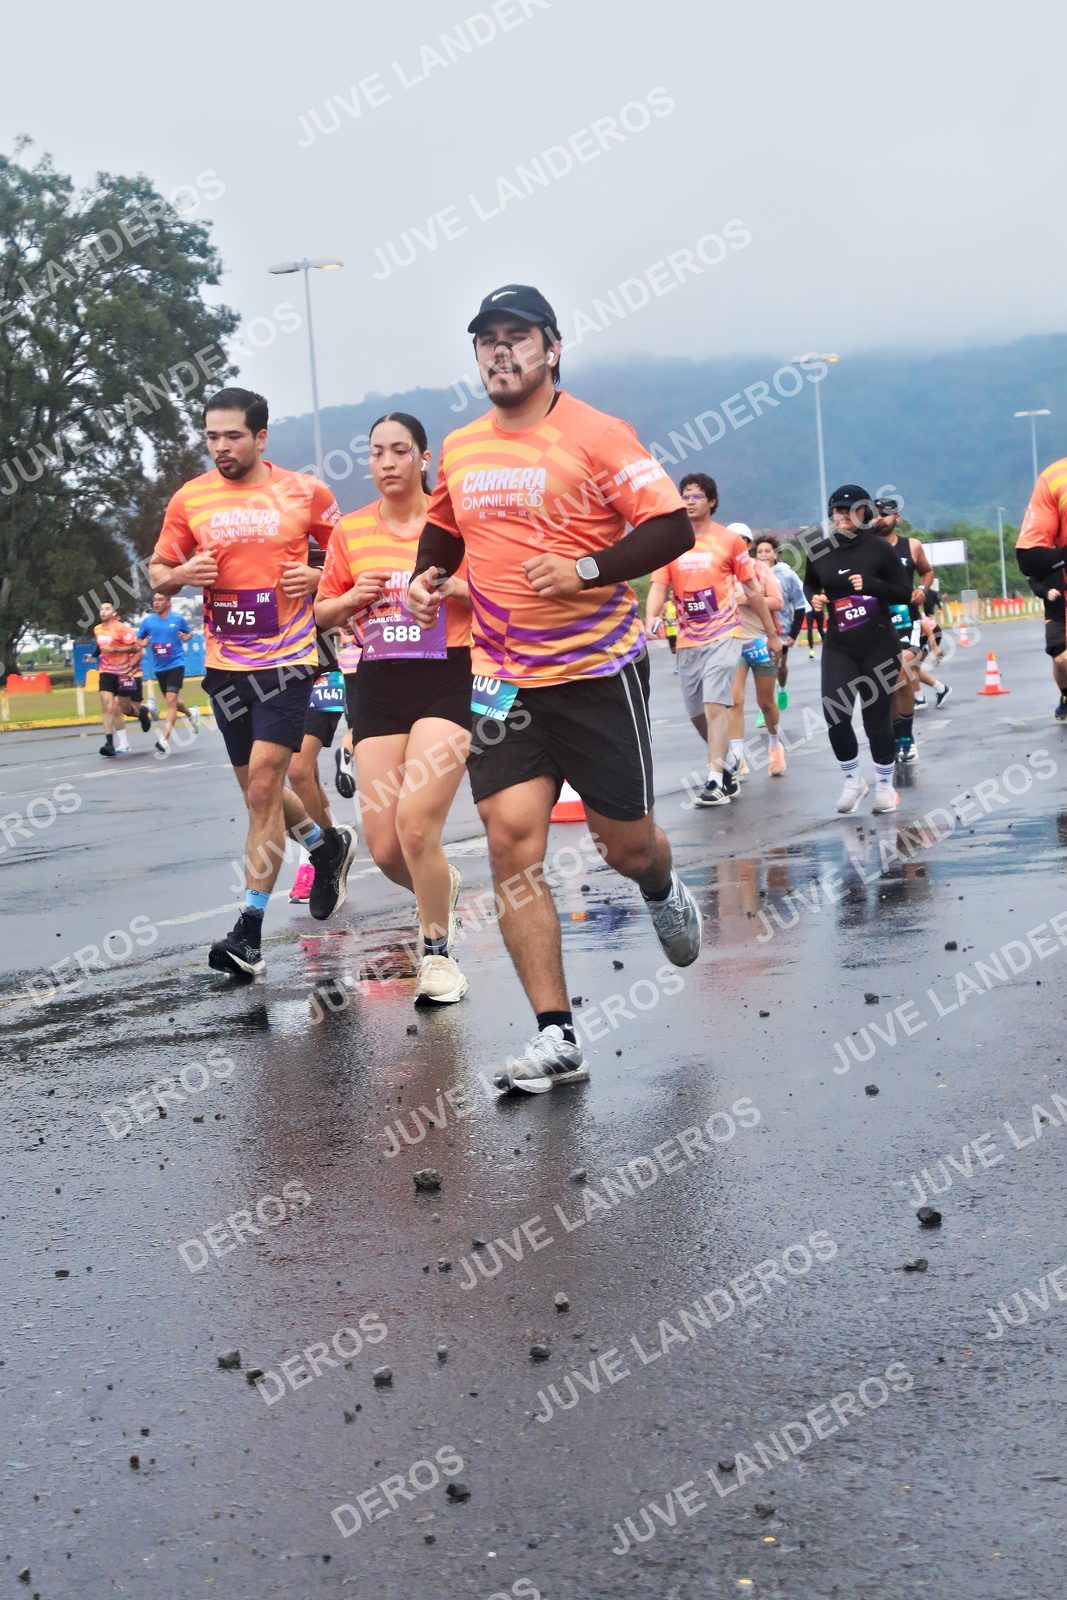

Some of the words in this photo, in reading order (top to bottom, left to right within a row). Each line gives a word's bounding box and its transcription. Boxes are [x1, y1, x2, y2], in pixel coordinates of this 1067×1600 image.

[462, 467, 546, 494] CARRERA
[462, 492, 525, 511] OMNILIFE
[211, 508, 280, 529] CARRERA
[210, 526, 264, 541] OMNILIFE
[256, 592, 270, 603] 15K
[687, 601, 706, 611] 538
[845, 606, 867, 621] 628
[226, 610, 256, 626] 475
[382, 625, 421, 643] 688
